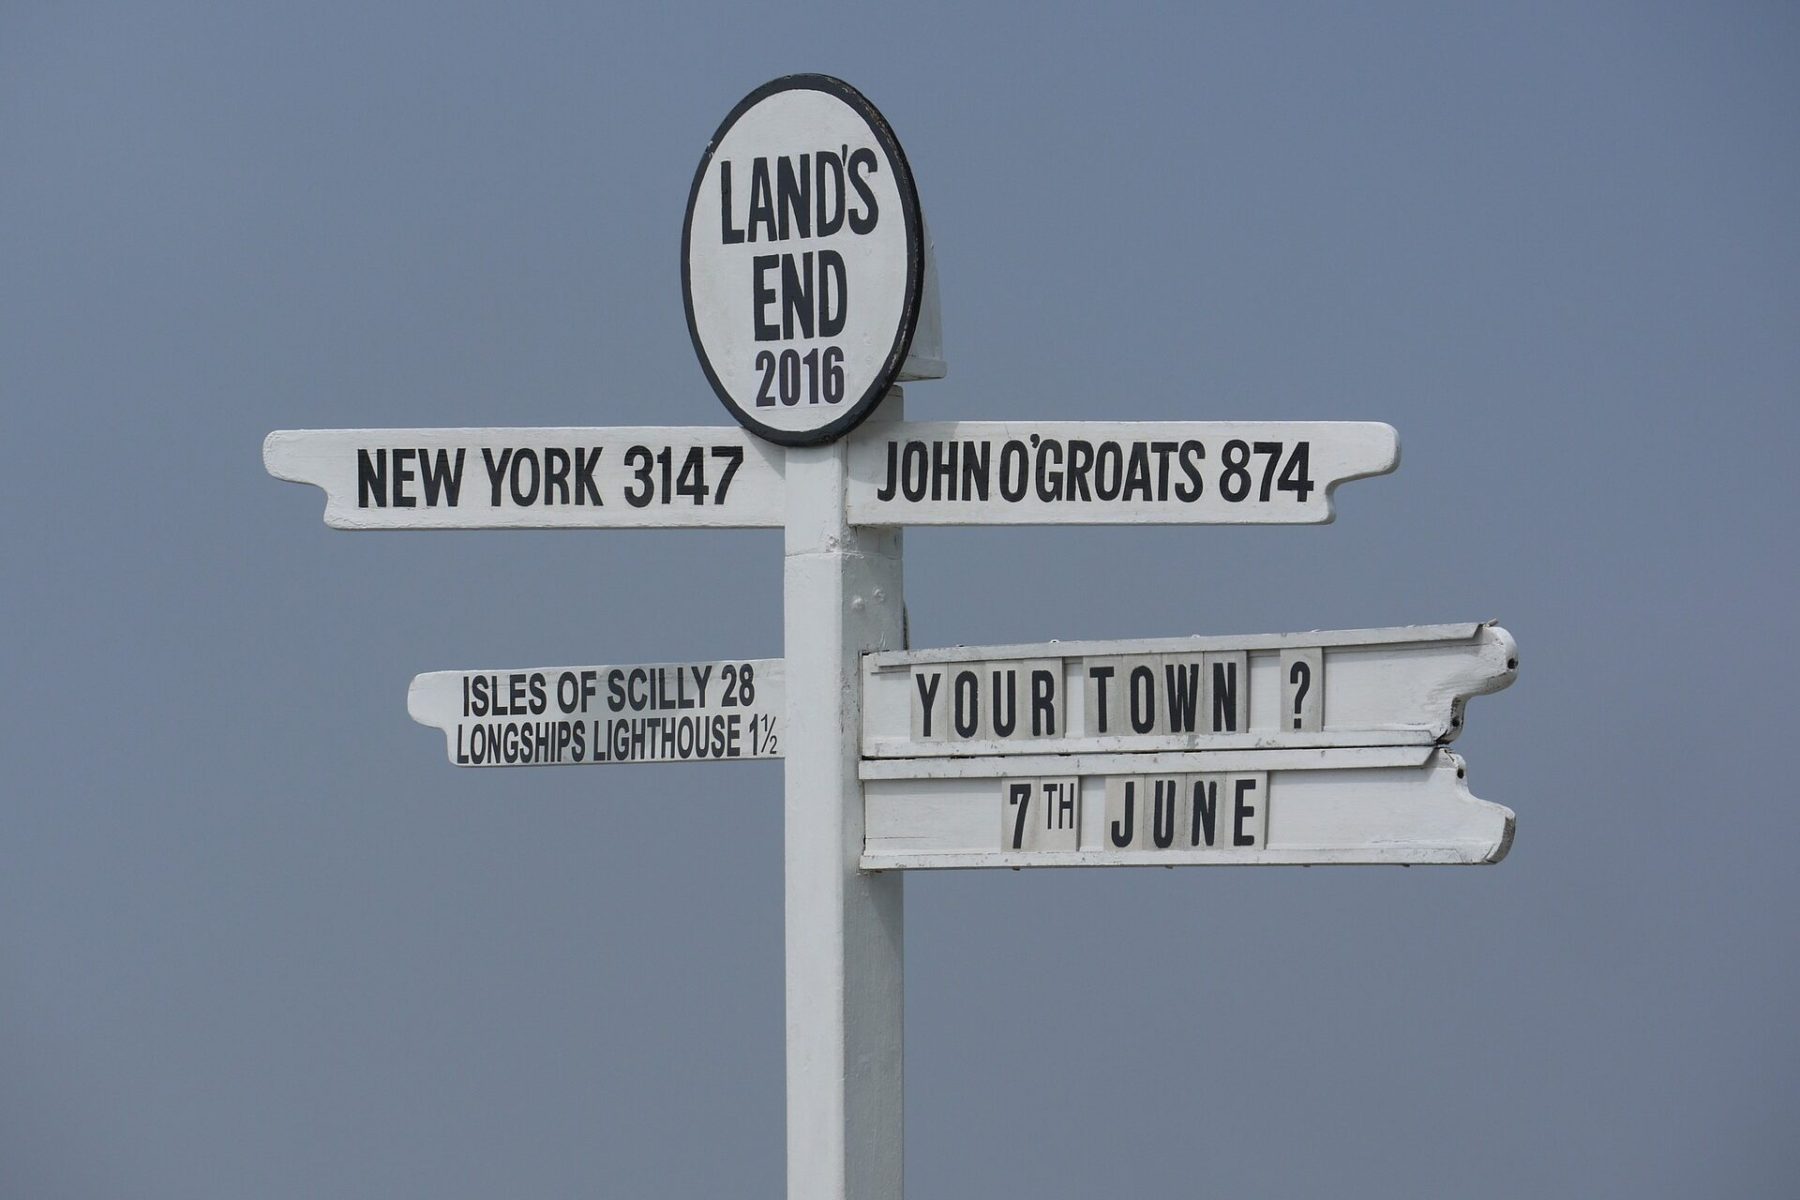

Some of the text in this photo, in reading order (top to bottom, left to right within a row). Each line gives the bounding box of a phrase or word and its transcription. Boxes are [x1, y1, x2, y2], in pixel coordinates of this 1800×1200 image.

[721, 144, 879, 245] LAND'S
[753, 250, 848, 342] END
[756, 346, 845, 407] 2016
[357, 445, 744, 508] NEW YORK 3147
[877, 433, 1314, 503] JOHN O'GROATS 874
[463, 663, 755, 717] ISLES OF SCILLY 28
[915, 660, 1311, 738] YOUR TOWN ?
[457, 720, 586, 765] LONGSHIPS
[593, 714, 741, 762] LIGHTHOUSE
[1009, 778, 1256, 850] 7TH JUNE
